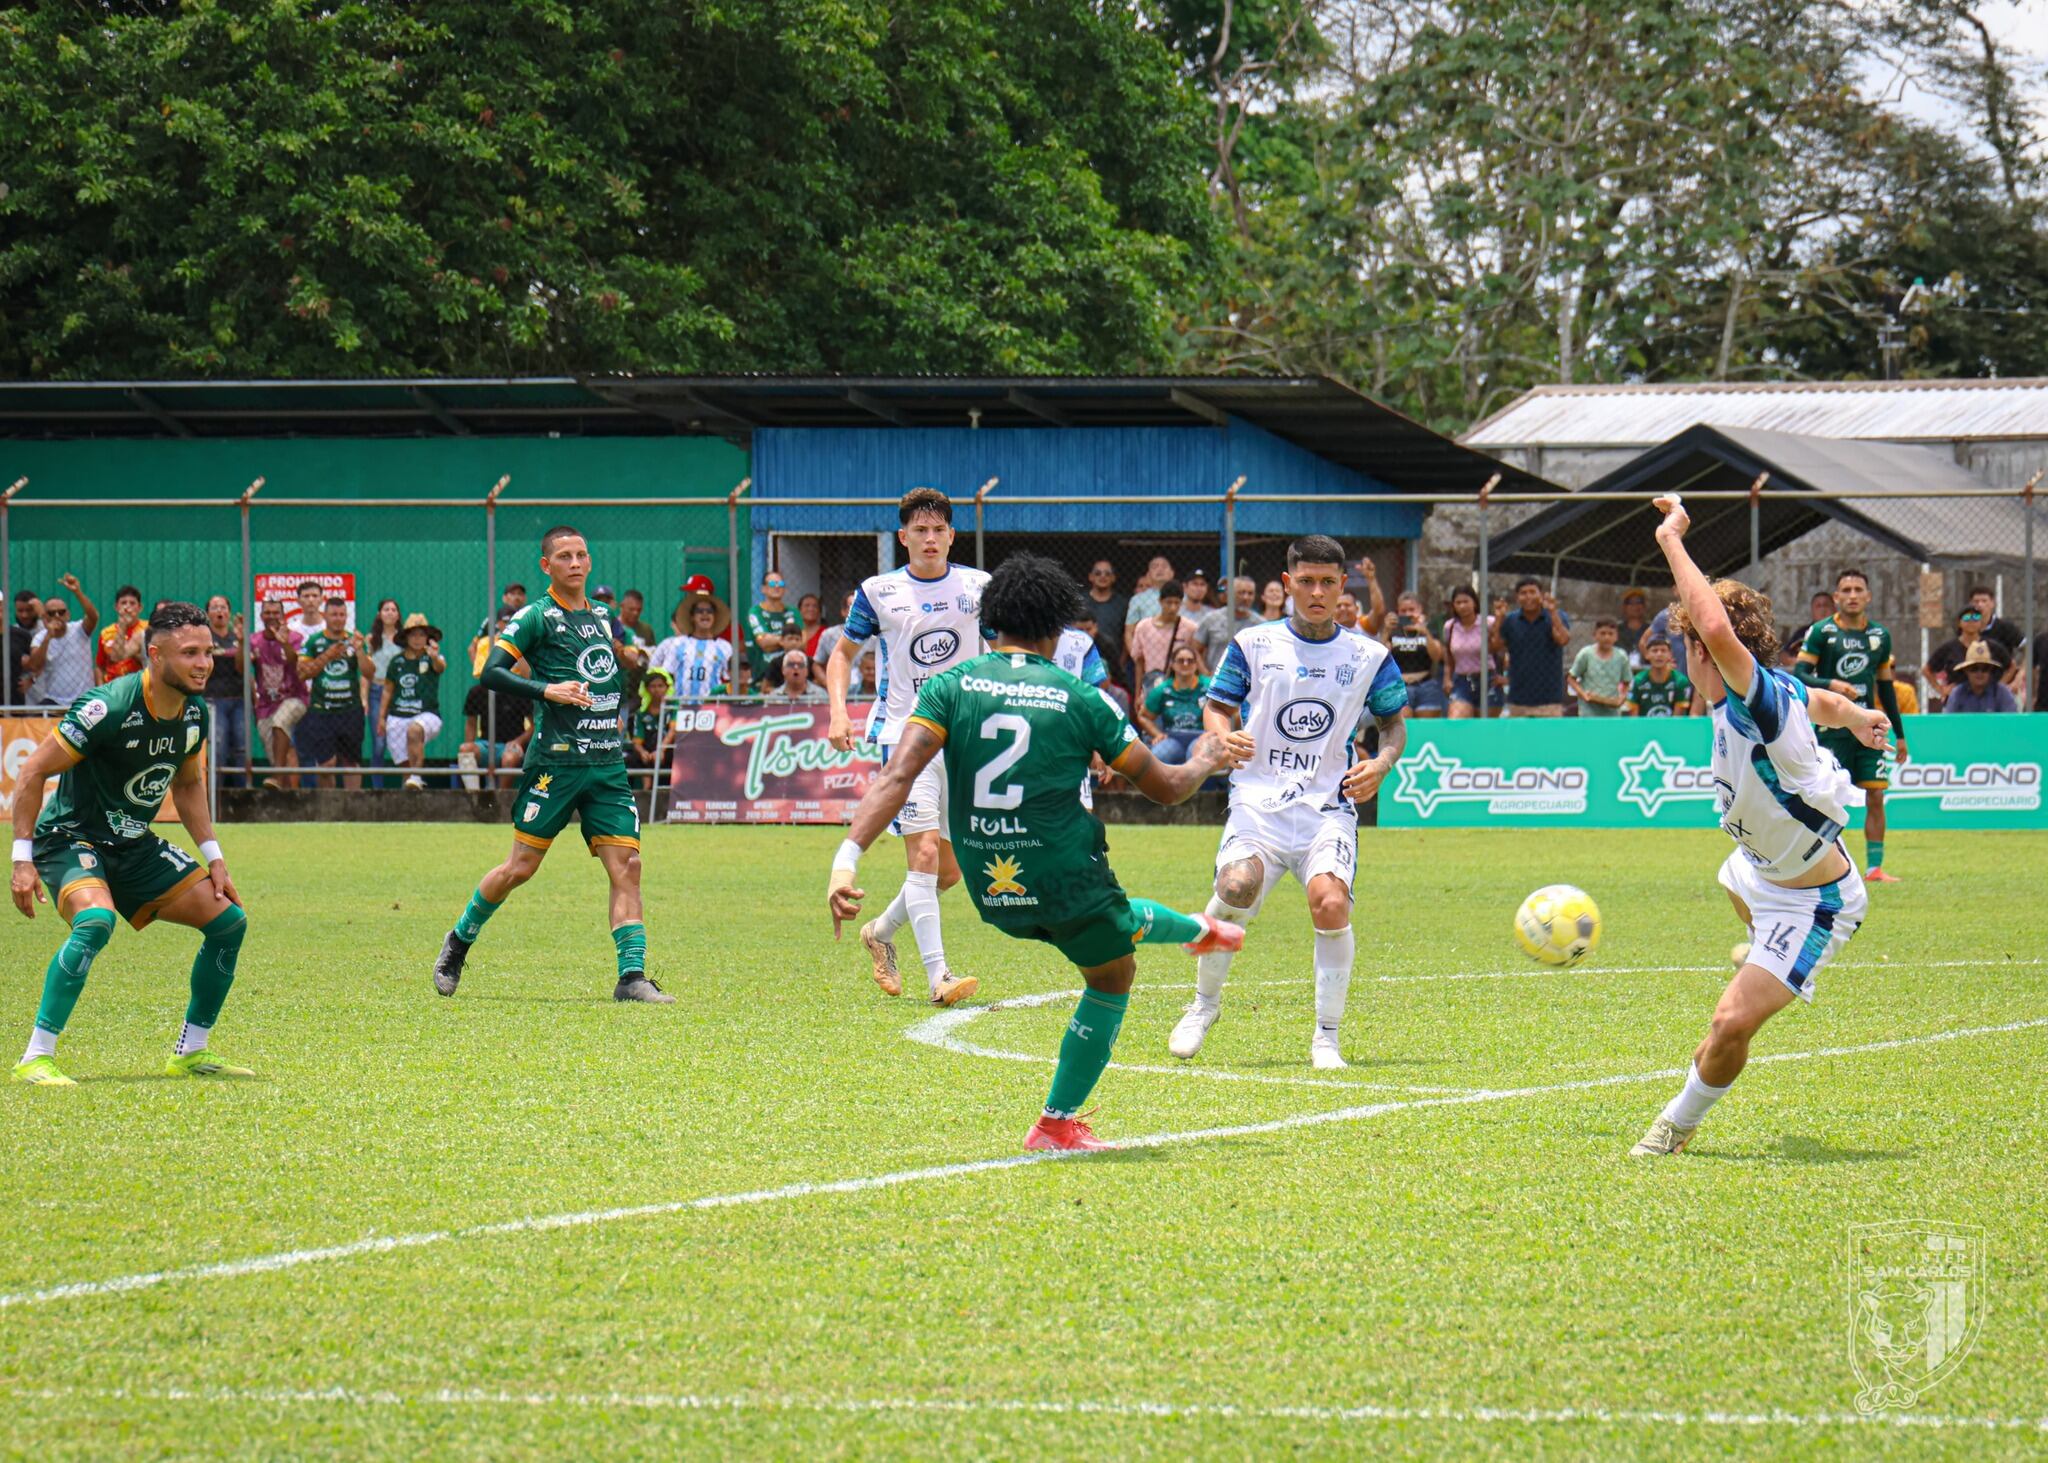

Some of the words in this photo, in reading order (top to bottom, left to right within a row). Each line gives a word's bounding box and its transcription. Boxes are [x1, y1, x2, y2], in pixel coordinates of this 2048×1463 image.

[575, 624, 604, 639] UPL
[920, 638, 955, 658] Laky
[1843, 637, 1865, 649] UPL
[688, 666, 706, 681] 10
[960, 675, 1069, 704] Coopelesca
[1004, 697, 1067, 713] ALMACENES
[1289, 708, 1329, 733] Laky
[149, 737, 176, 756] UPL
[973, 713, 1031, 810] 2
[1269, 747, 1321, 771] FÉNI
[823, 773, 867, 790] PIZZA
[1449, 770, 1584, 790] COLONO
[1900, 766, 2037, 786] COLONO
[1492, 799, 1584, 810] AGROPECUARIO
[1943, 796, 2037, 806] AGROPECUARIO
[985, 839, 1043, 850] INDUSTRIAL
[1766, 922, 1797, 952] 14
